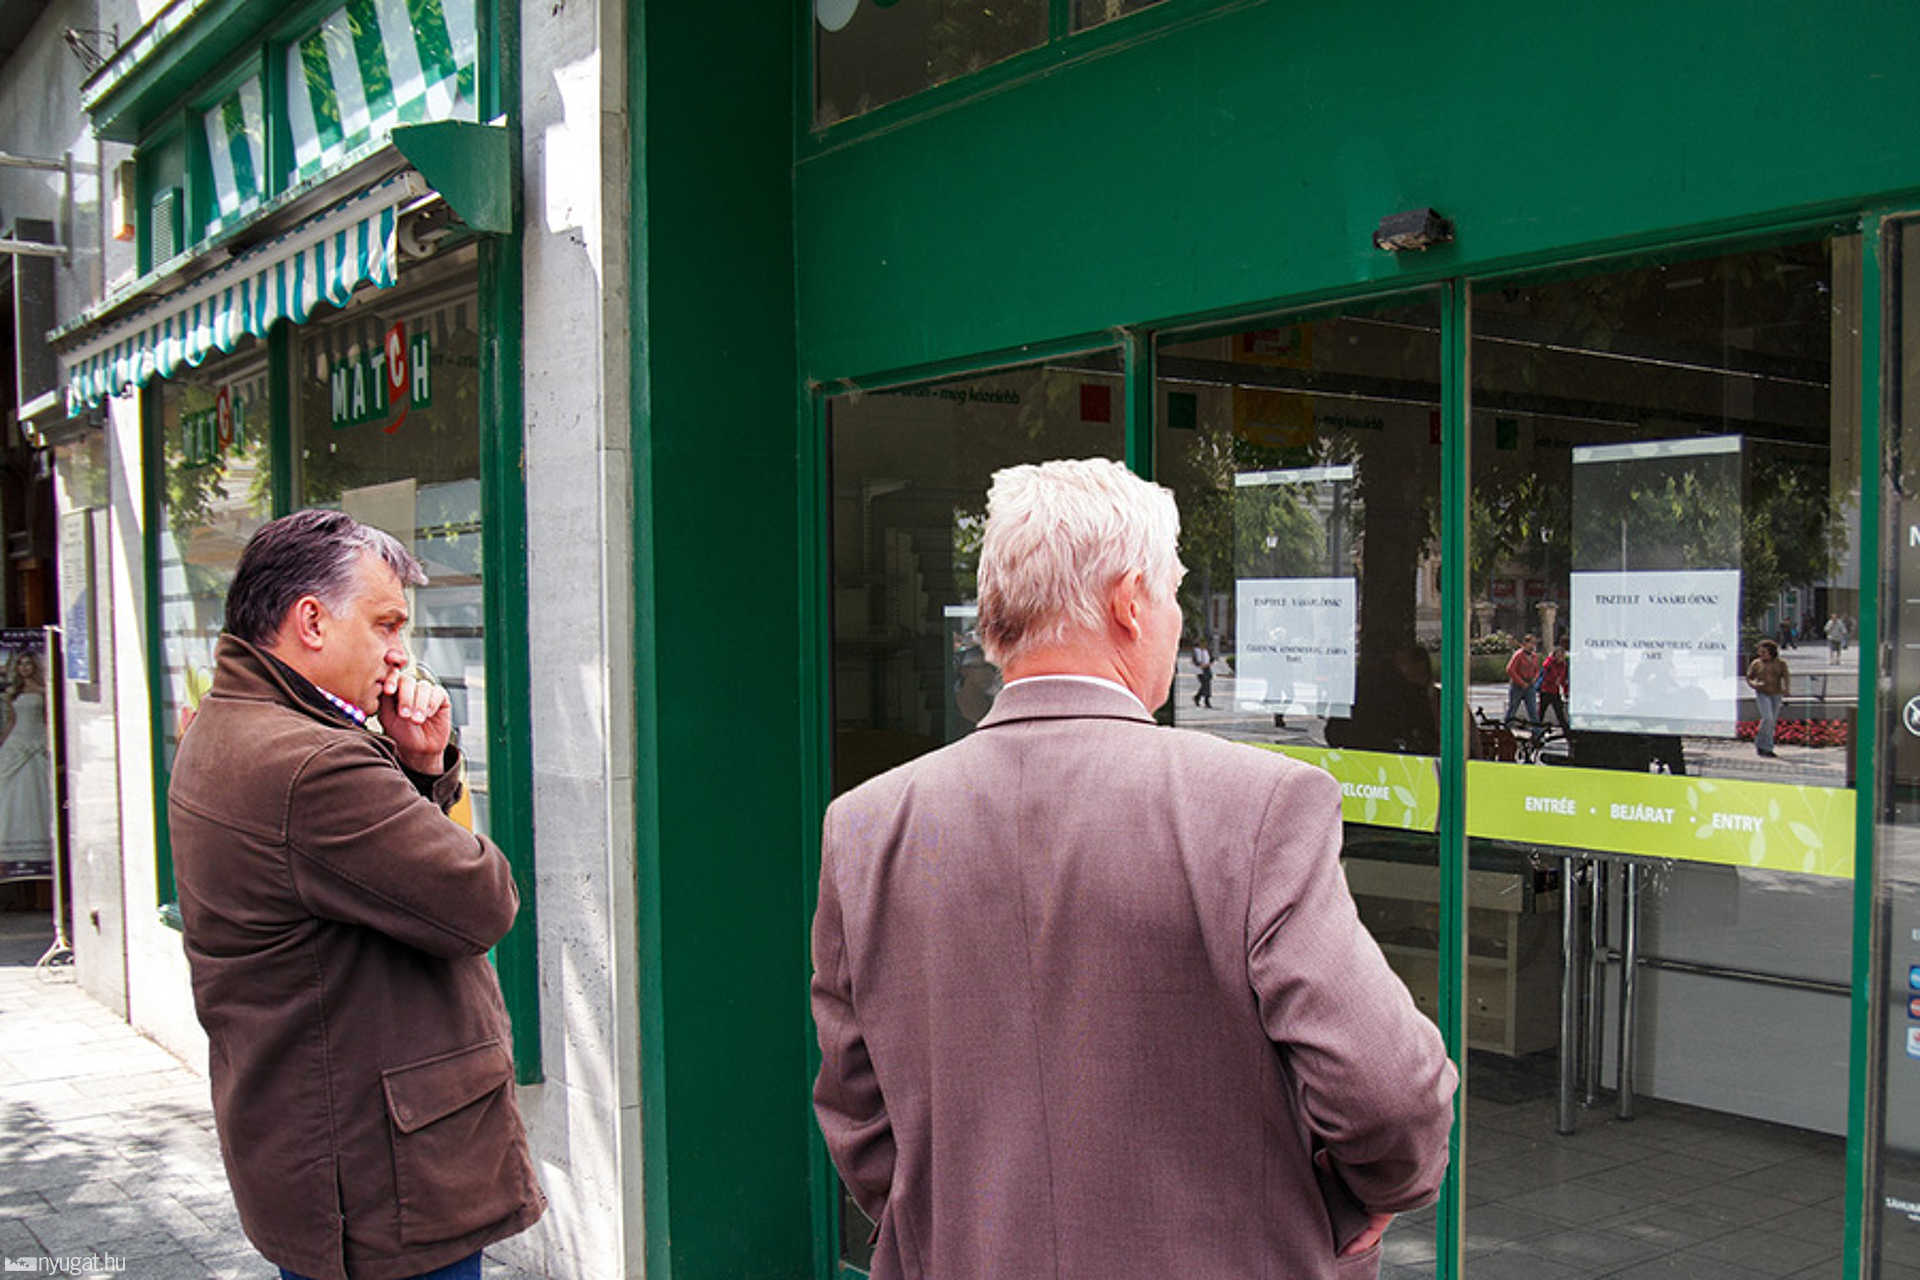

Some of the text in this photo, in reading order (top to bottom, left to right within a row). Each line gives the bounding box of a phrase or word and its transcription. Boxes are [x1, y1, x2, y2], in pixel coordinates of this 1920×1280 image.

[331, 322, 431, 425] MATCH
[1341, 782, 1390, 801] ELCOME
[1525, 795, 1764, 833] ENTRÉE BEJÁRAT ENTRY
